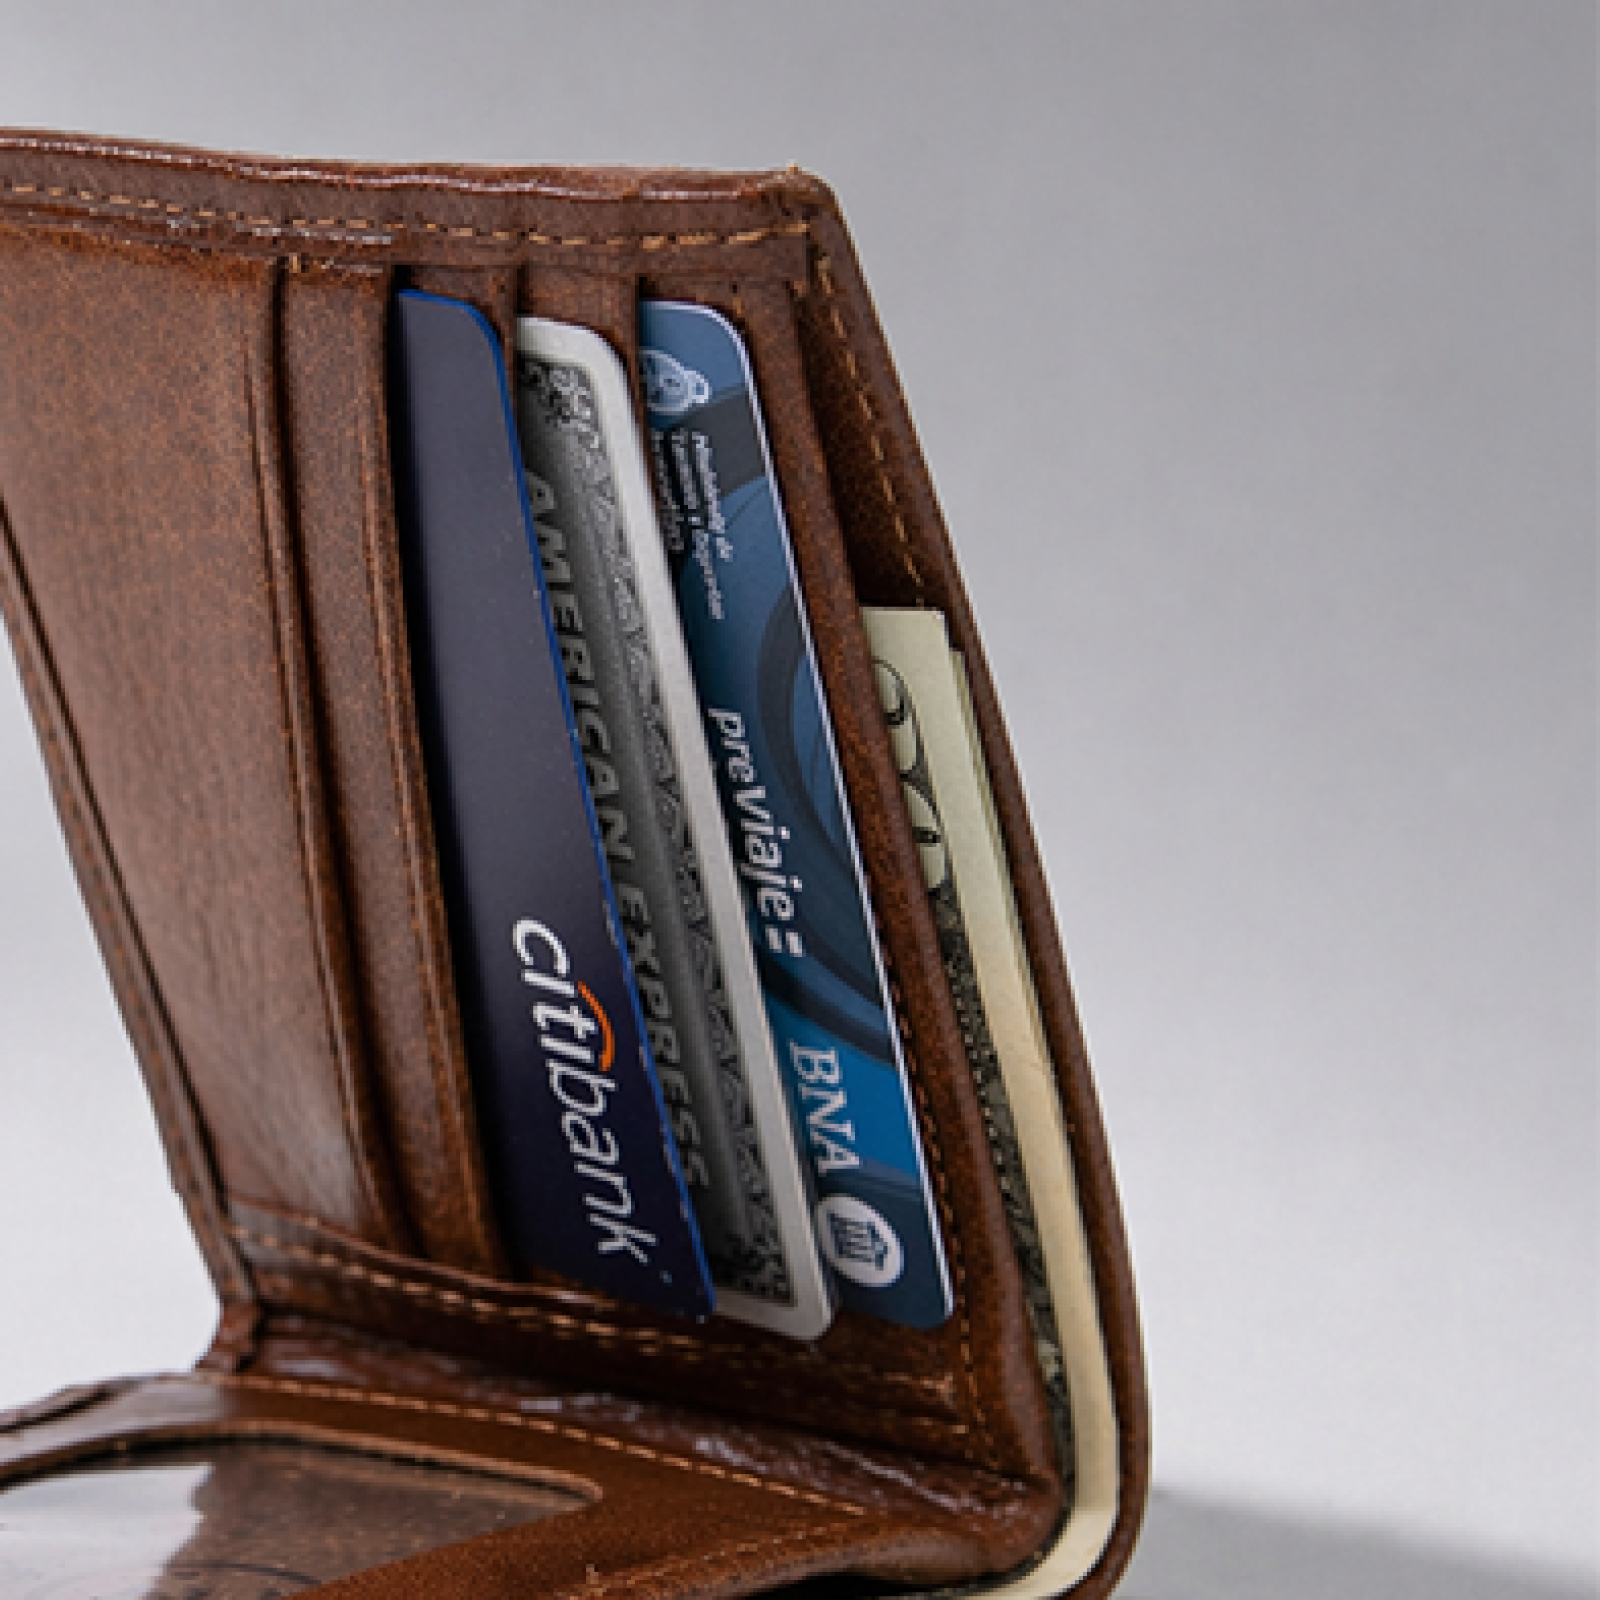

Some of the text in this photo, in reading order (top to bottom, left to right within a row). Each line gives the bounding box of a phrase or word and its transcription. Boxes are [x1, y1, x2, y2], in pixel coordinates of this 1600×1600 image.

[524, 470, 709, 1186] AMERICAN EXPRESS
[512, 918, 658, 1264] citibank
[788, 1039, 861, 1174] BNA
